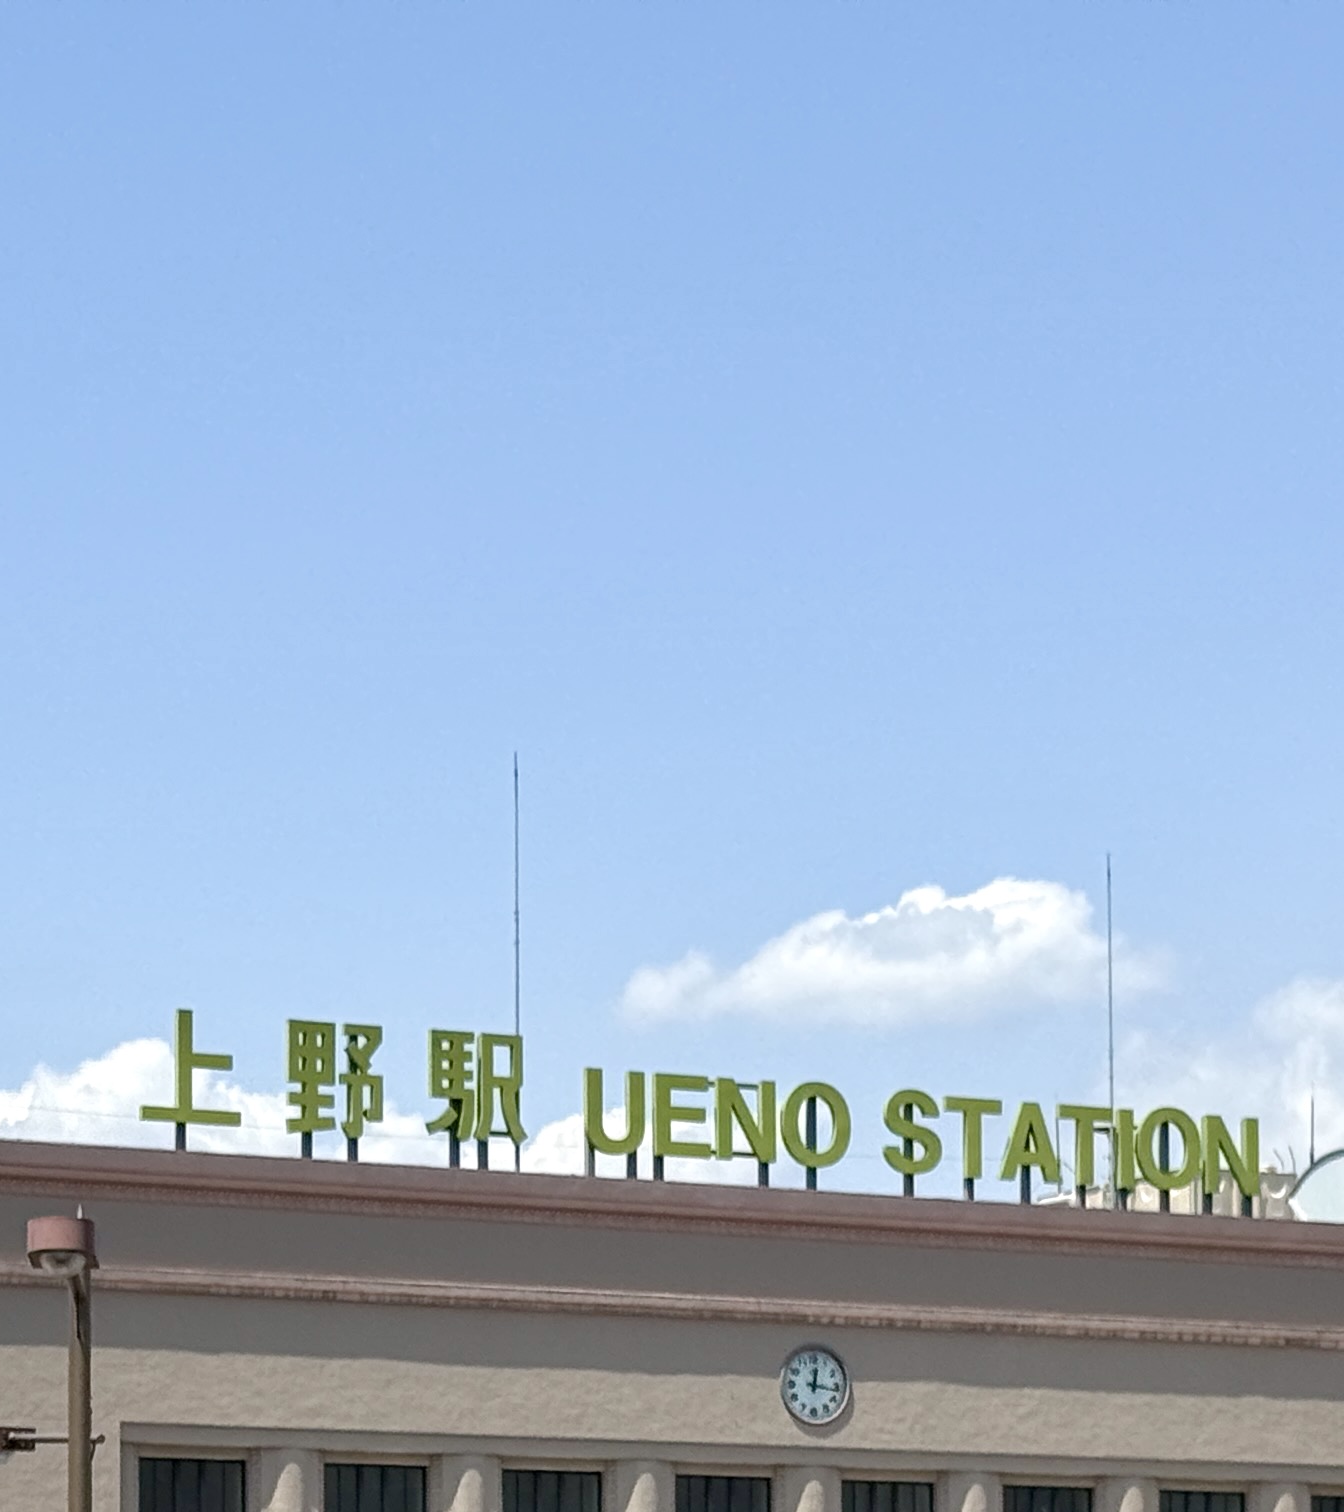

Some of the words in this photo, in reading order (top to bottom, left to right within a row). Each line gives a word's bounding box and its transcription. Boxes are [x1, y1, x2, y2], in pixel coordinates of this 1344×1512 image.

[140, 1009, 528, 1144] 上野駅
[583, 1067, 852, 1169] UENO
[882, 1089, 1258, 1197] STATION
